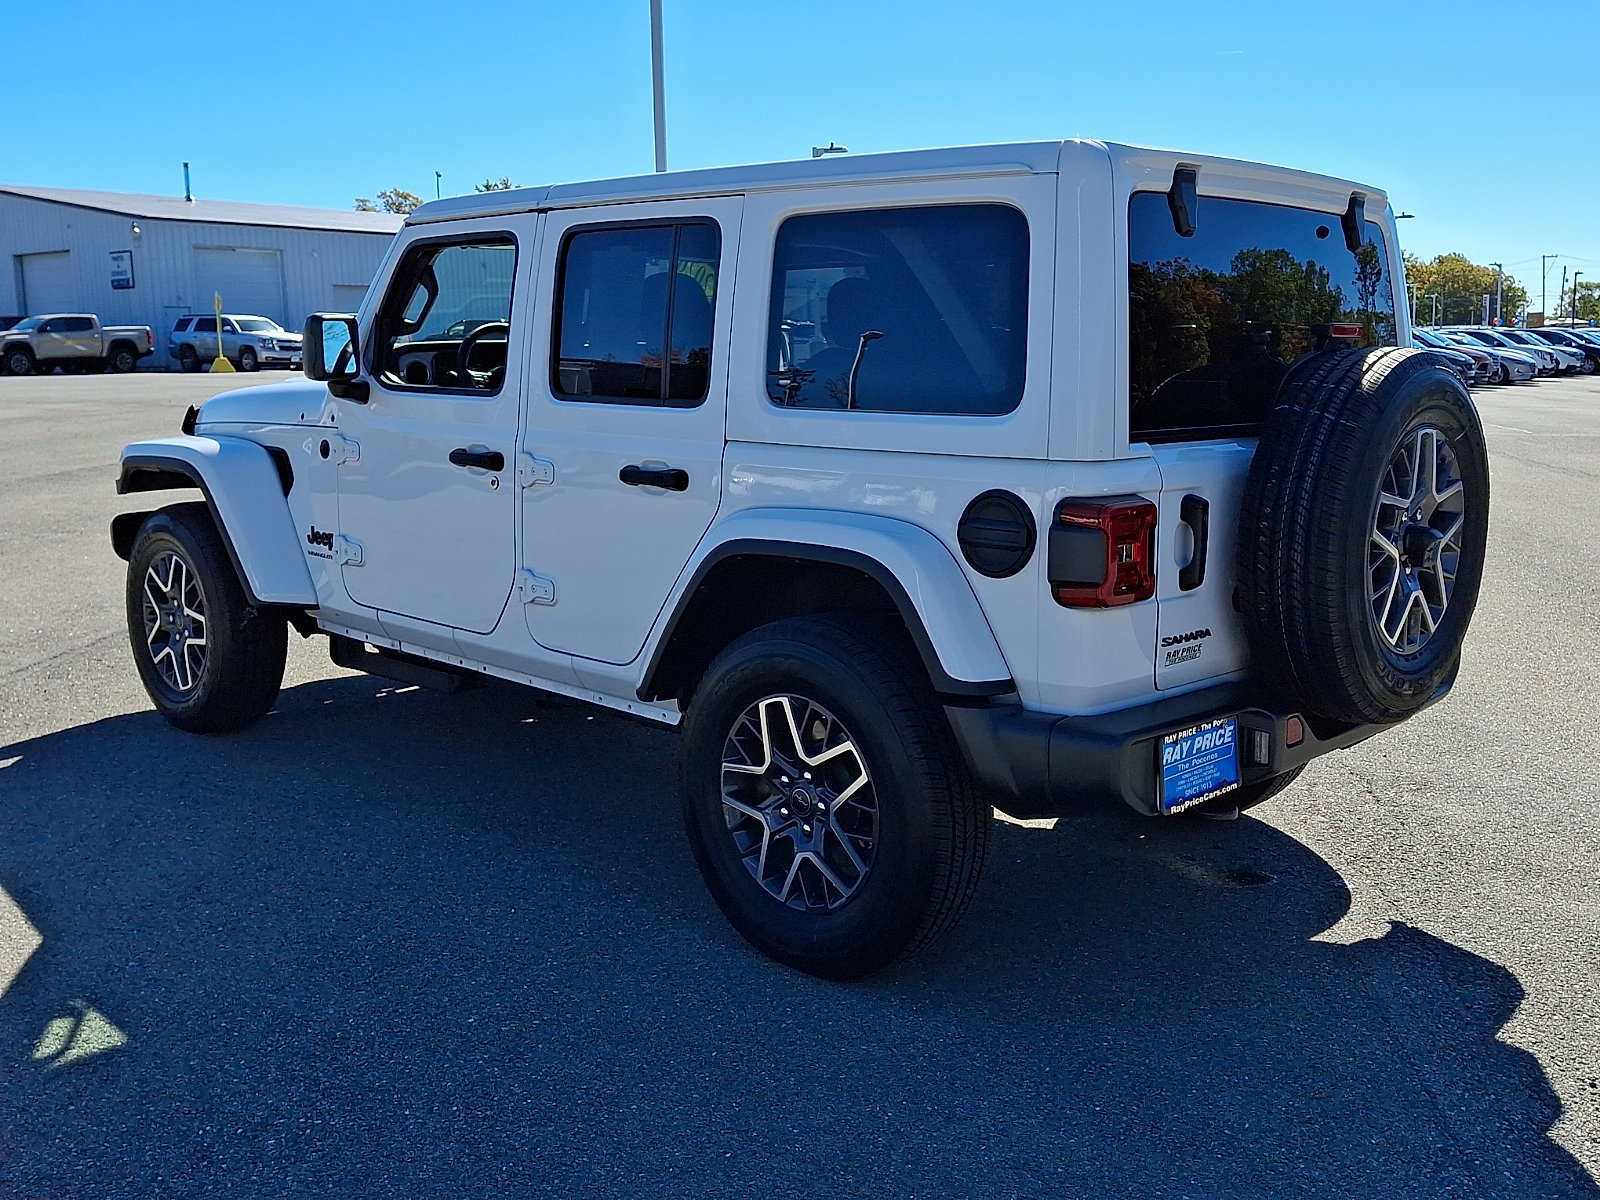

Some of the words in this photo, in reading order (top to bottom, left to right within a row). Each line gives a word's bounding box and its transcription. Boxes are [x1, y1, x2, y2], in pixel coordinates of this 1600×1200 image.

[307, 526, 334, 551] Jeep
[1161, 628, 1212, 647] SAHARA
[1166, 648, 1181, 660] RAY
[1181, 643, 1203, 656] PRICE
[1165, 732, 1177, 744] RAY
[1178, 727, 1197, 739] PRICE
[1163, 739, 1191, 765] RAY
[1193, 725, 1234, 754] PRICE
[1178, 762, 1189, 771] The
[1192, 753, 1218, 766] Poconos
[1171, 783, 1238, 814] RayPriceCars.com
[1184, 786, 1200, 797] SINCE
